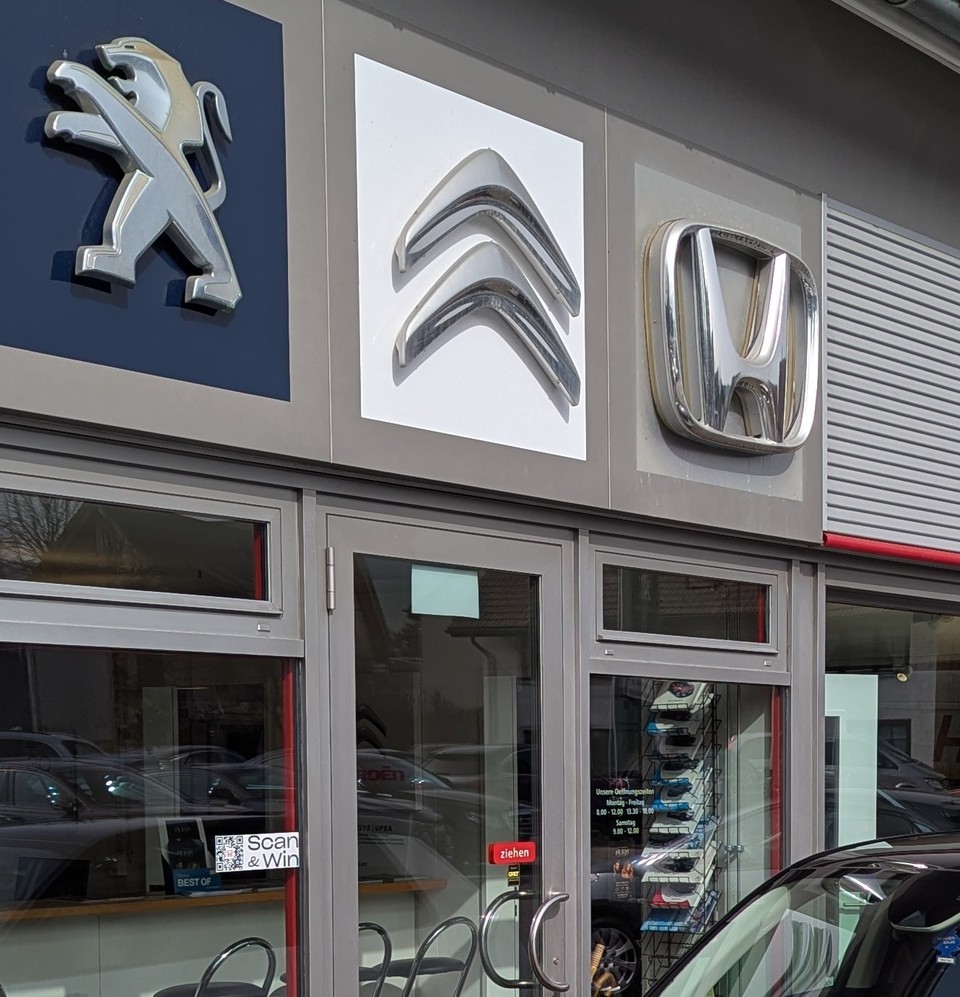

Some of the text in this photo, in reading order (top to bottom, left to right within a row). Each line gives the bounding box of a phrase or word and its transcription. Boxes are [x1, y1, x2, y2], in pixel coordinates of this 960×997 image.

[248, 835, 299, 850] Scan
[248, 850, 299, 868] & Win
[500, 847, 529, 859] ziehen
[178, 877, 211, 887] BEST OF
